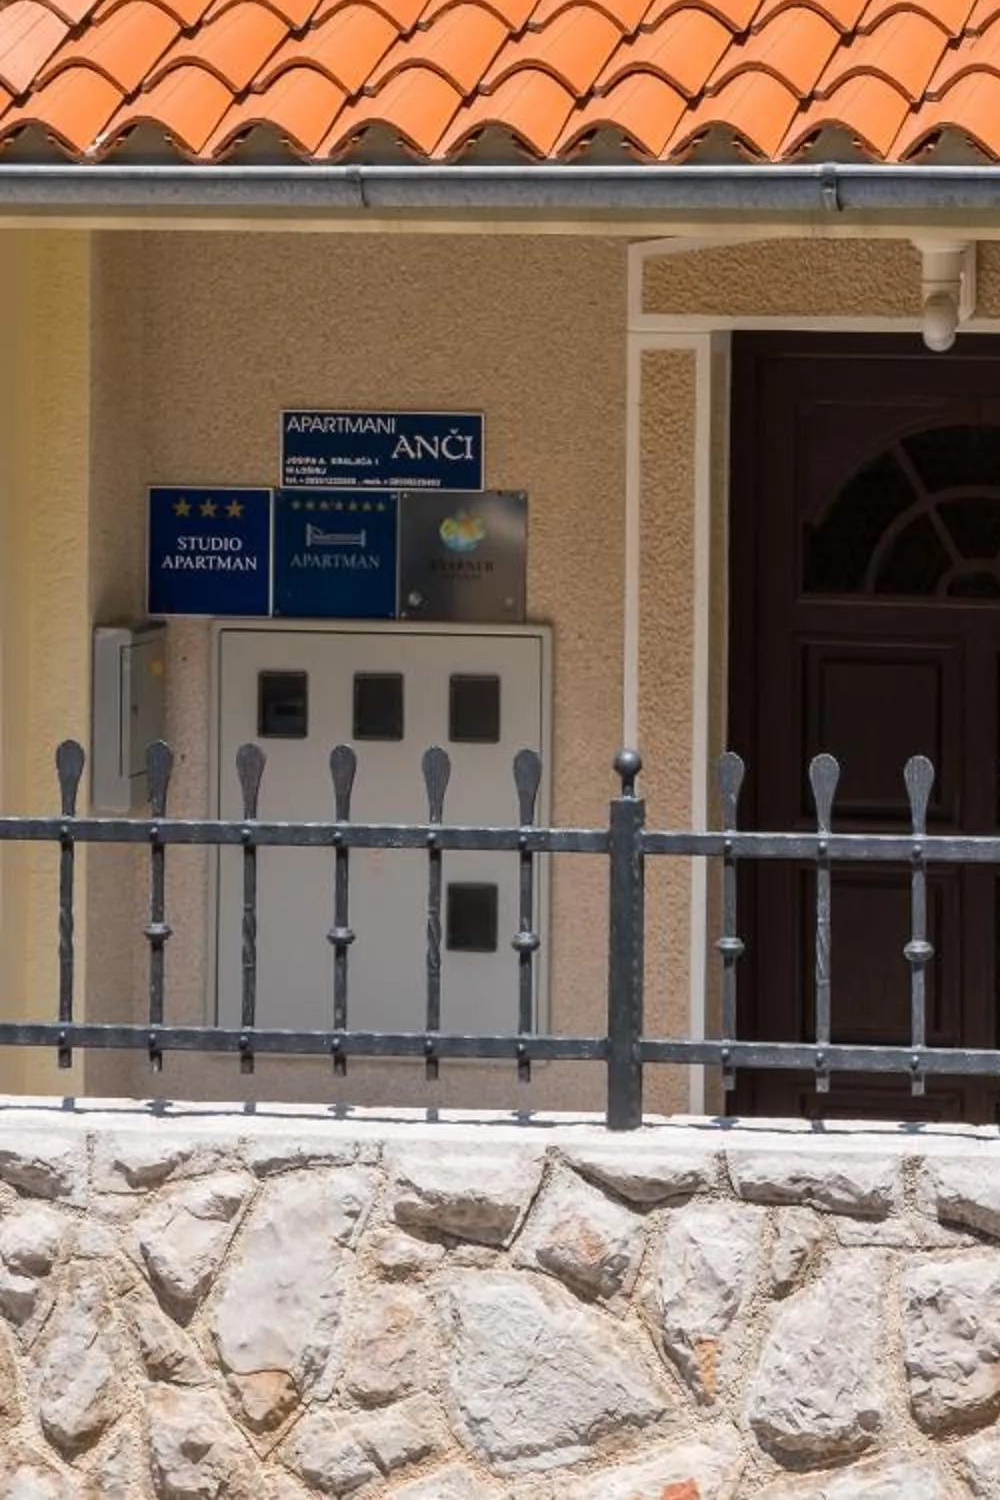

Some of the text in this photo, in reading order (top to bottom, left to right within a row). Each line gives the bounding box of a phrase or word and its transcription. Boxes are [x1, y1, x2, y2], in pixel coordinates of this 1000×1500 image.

[286, 415, 396, 434] APARTMANI
[391, 428, 474, 460] ANČI
[176, 536, 242, 552] STUDIO
[160, 554, 258, 571] APARTMAN
[289, 553, 380, 570] APARTMAN
